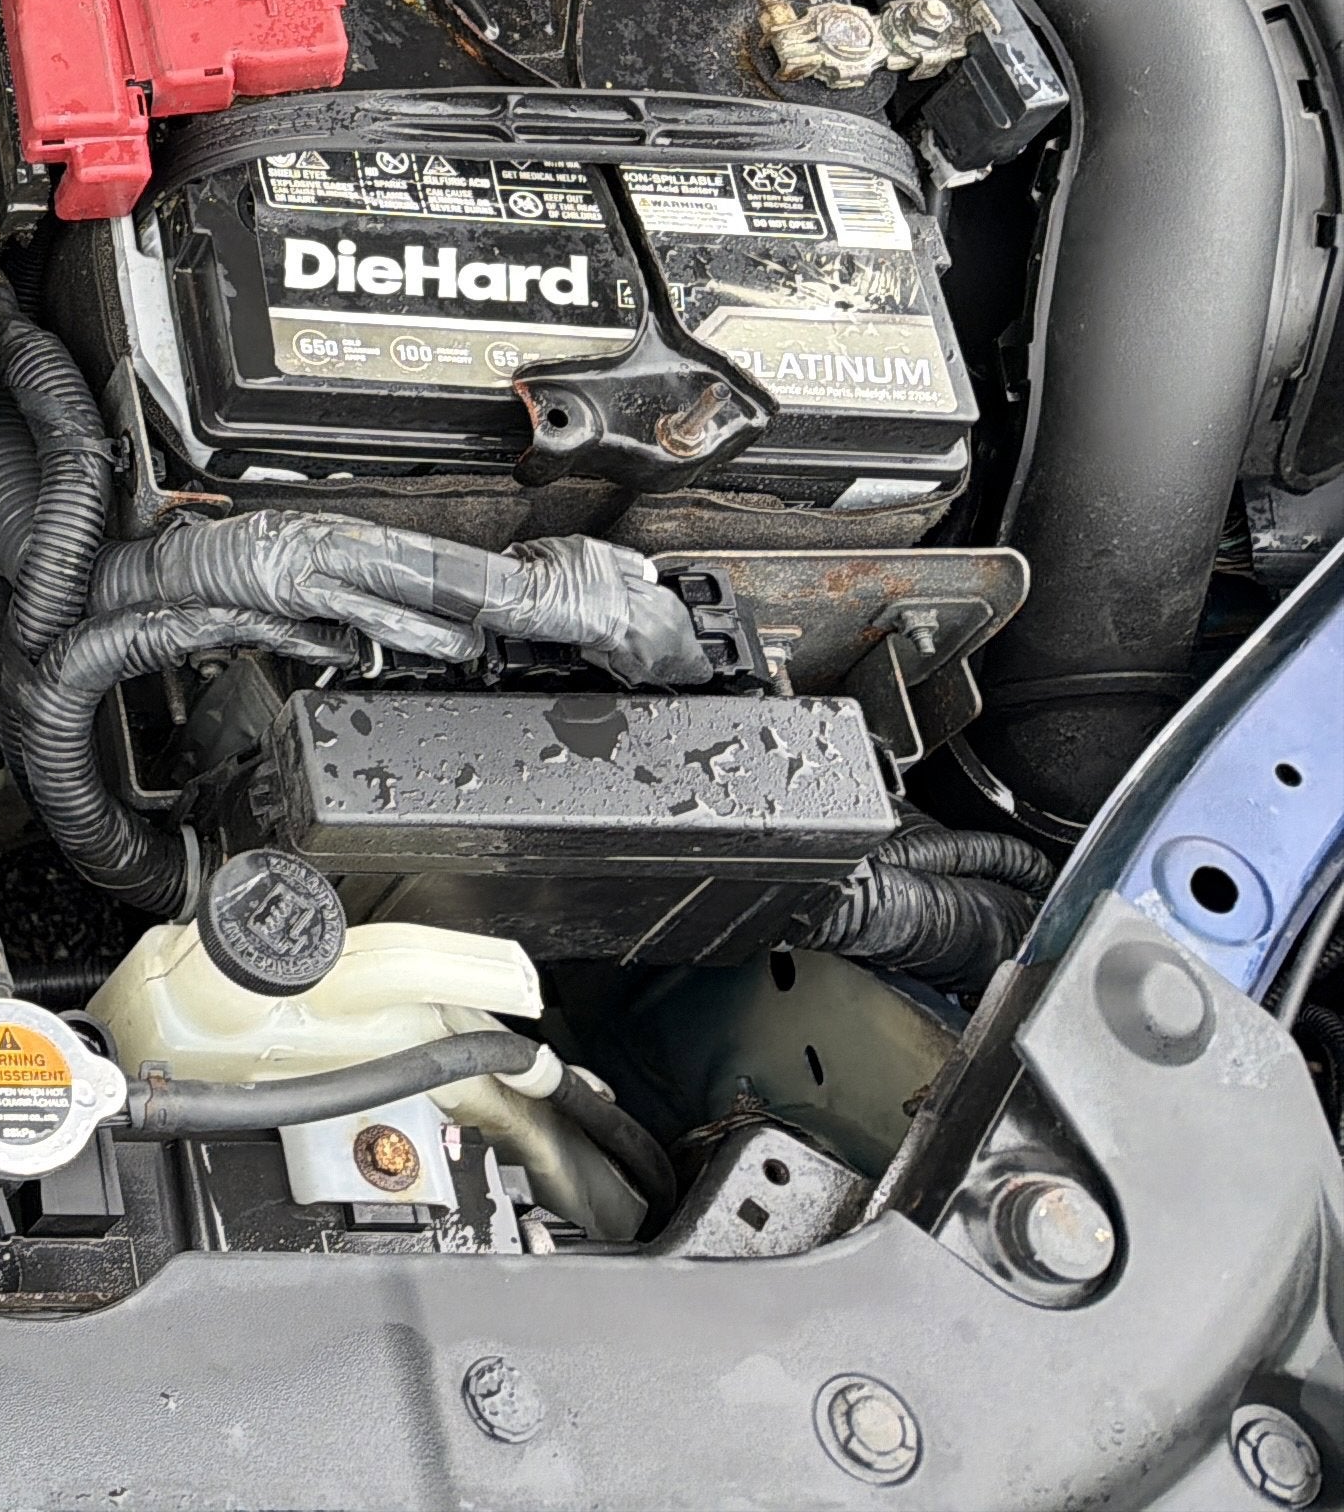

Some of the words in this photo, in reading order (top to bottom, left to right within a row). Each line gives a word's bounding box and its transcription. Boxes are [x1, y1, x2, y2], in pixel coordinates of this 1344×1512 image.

[268, 168, 301, 179] SHIELD
[365, 167, 379, 177] NO
[502, 170, 517, 180] GET
[520, 171, 554, 182] MEDICAL
[556, 173, 576, 183] HELP
[628, 183, 654, 192] Lead
[656, 185, 680, 194] Acid
[681, 186, 719, 197] Battery
[543, 193, 564, 202] KEEP
[566, 195, 583, 204] OUT
[651, 200, 718, 211] WARNING:
[753, 219, 767, 228] DO
[283, 236, 589, 307] DieHard
[299, 338, 339, 356] 650
[396, 344, 433, 362] 100
[493, 350, 519, 367] 55
[803, 386, 825, 396] Auto
[893, 390, 906, 400] NC
[17, 1087, 44, 1096] WHEN
[45, 1087, 67, 1096] HOT.
